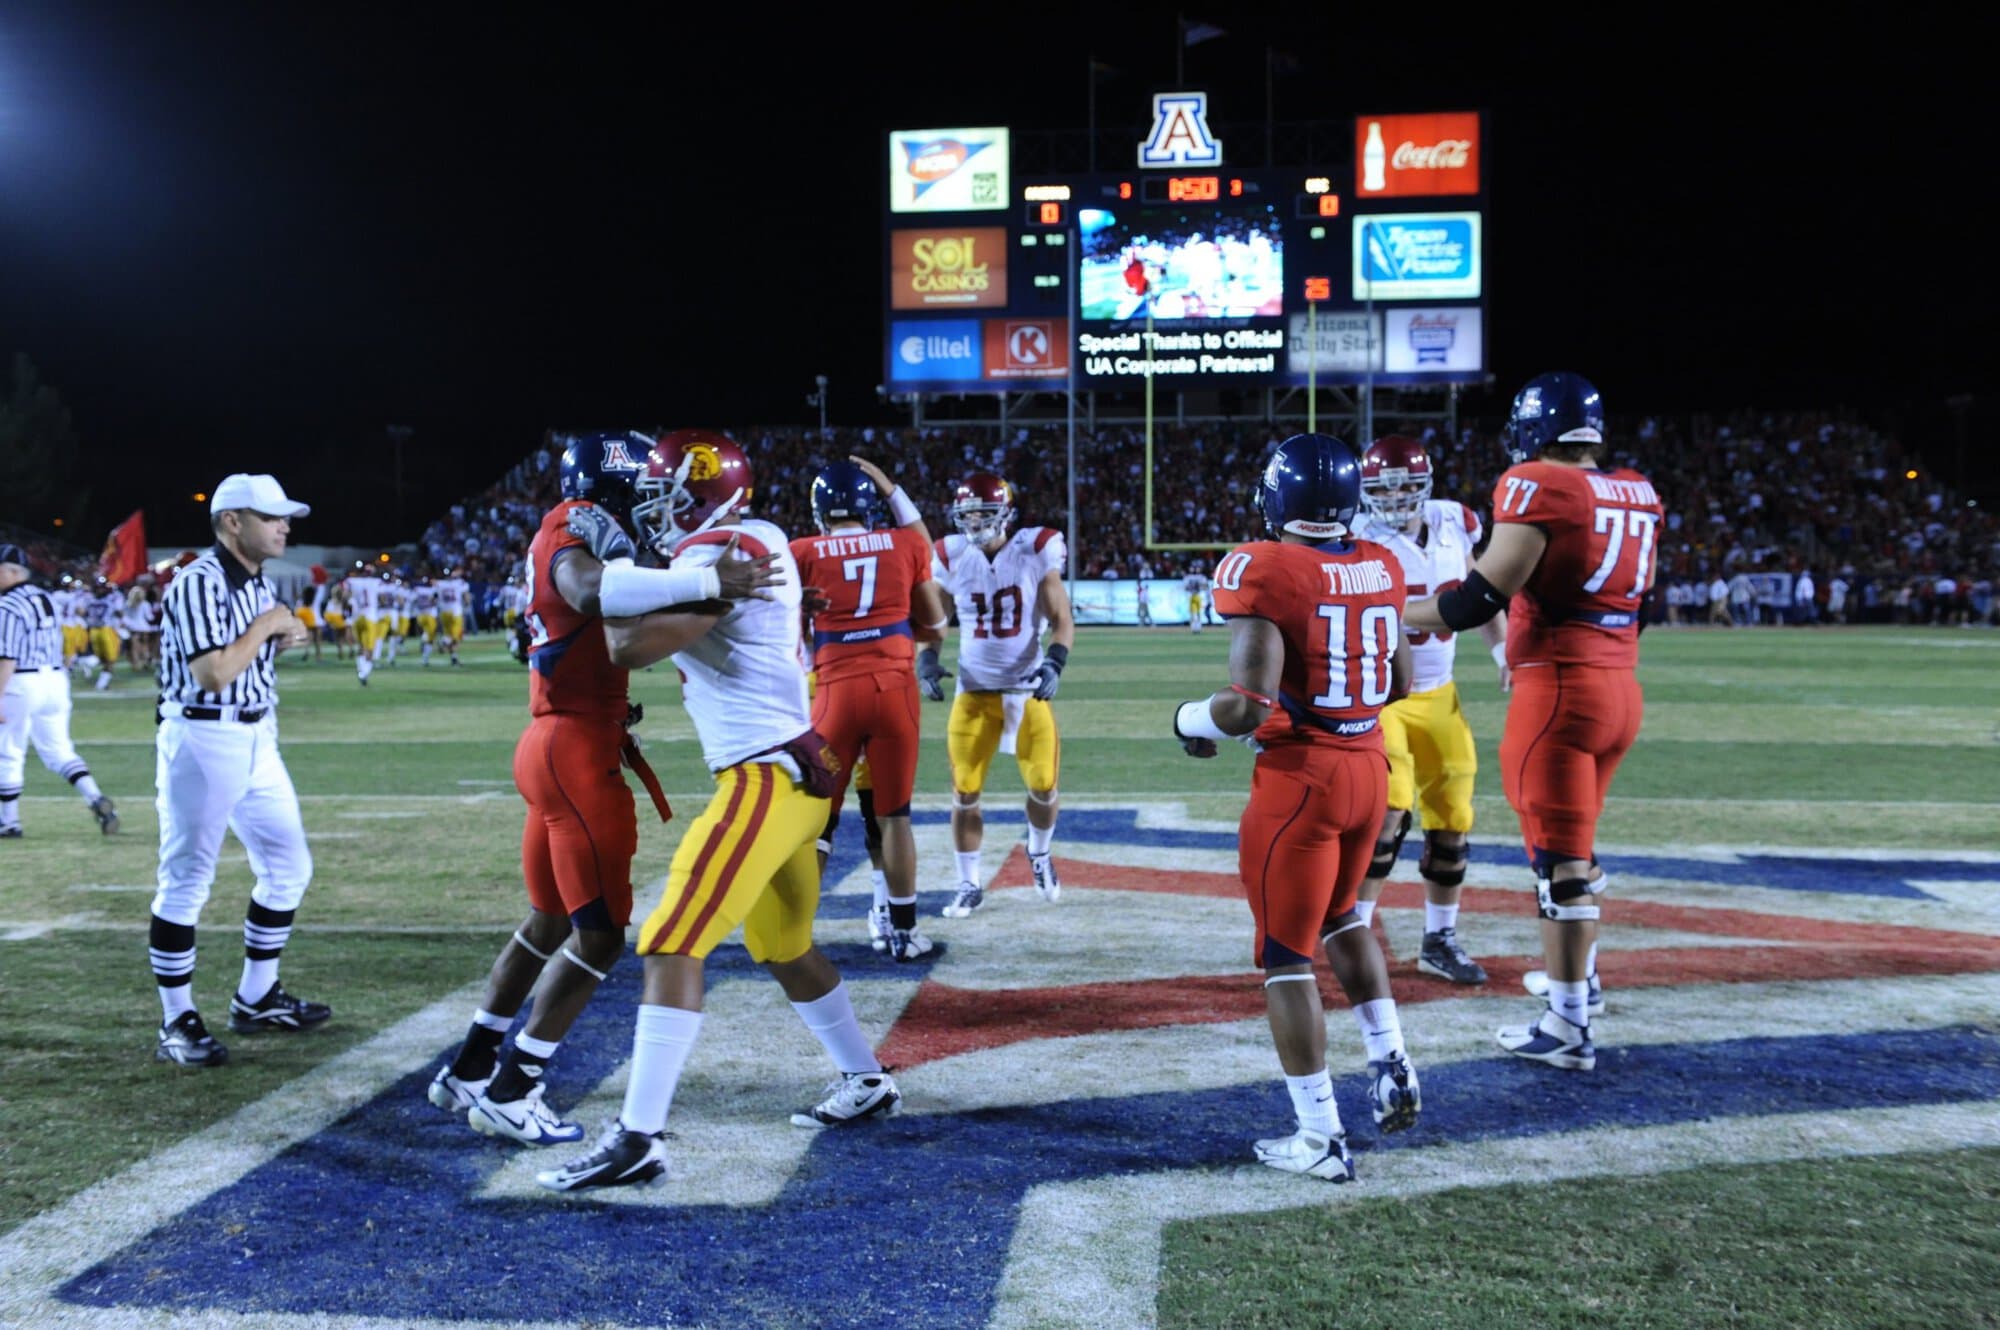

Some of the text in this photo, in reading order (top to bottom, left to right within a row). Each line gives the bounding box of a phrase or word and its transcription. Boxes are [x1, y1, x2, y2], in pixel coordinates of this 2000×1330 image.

[1138, 92, 1222, 168] A
[912, 237, 989, 274] SOL
[1079, 329, 1284, 355] Special Thanks to Official
[1085, 356, 1114, 375] UA
[1114, 355, 1197, 378] Corporate
[600, 440, 636, 471] A
[1502, 476, 1538, 516] 77
[813, 532, 894, 560] TUITAMA
[1582, 505, 1661, 600] 77
[842, 555, 878, 619] 7
[1212, 551, 1253, 591] 10
[970, 585, 1023, 639] 10
[1312, 602, 1400, 709] 10
